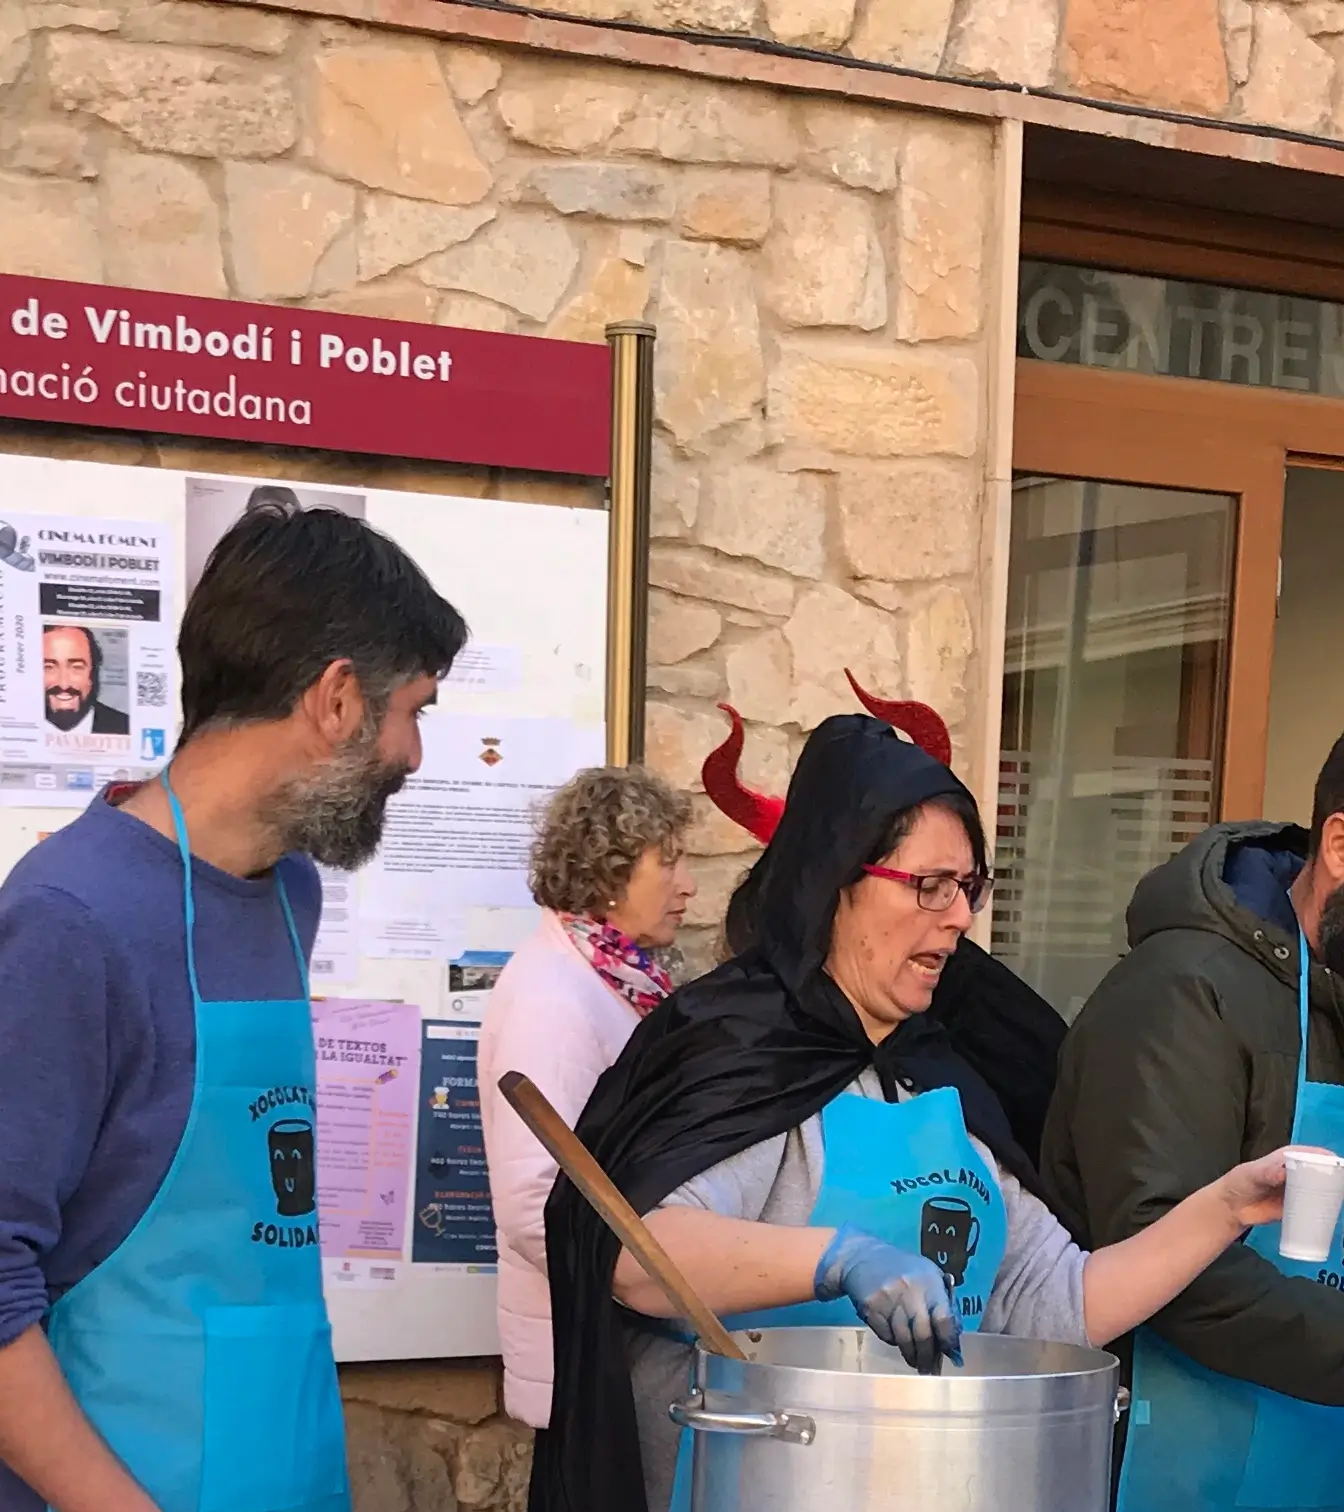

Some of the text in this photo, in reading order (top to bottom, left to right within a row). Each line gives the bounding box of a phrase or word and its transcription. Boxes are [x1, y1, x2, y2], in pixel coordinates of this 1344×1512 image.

[11, 297, 68, 338] de
[86, 306, 273, 364] Vimbodí
[288, 325, 303, 366] i
[318, 334, 453, 383] Poblet
[1023, 286, 1312, 392] CENTRE
[113, 369, 313, 427] ciutadana
[37, 529, 158, 548] CINEMA FOMENT
[108, 556, 160, 571] POBLET
[318, 1037, 388, 1053] DE TEXTOS
[322, 1050, 338, 1061] LA
